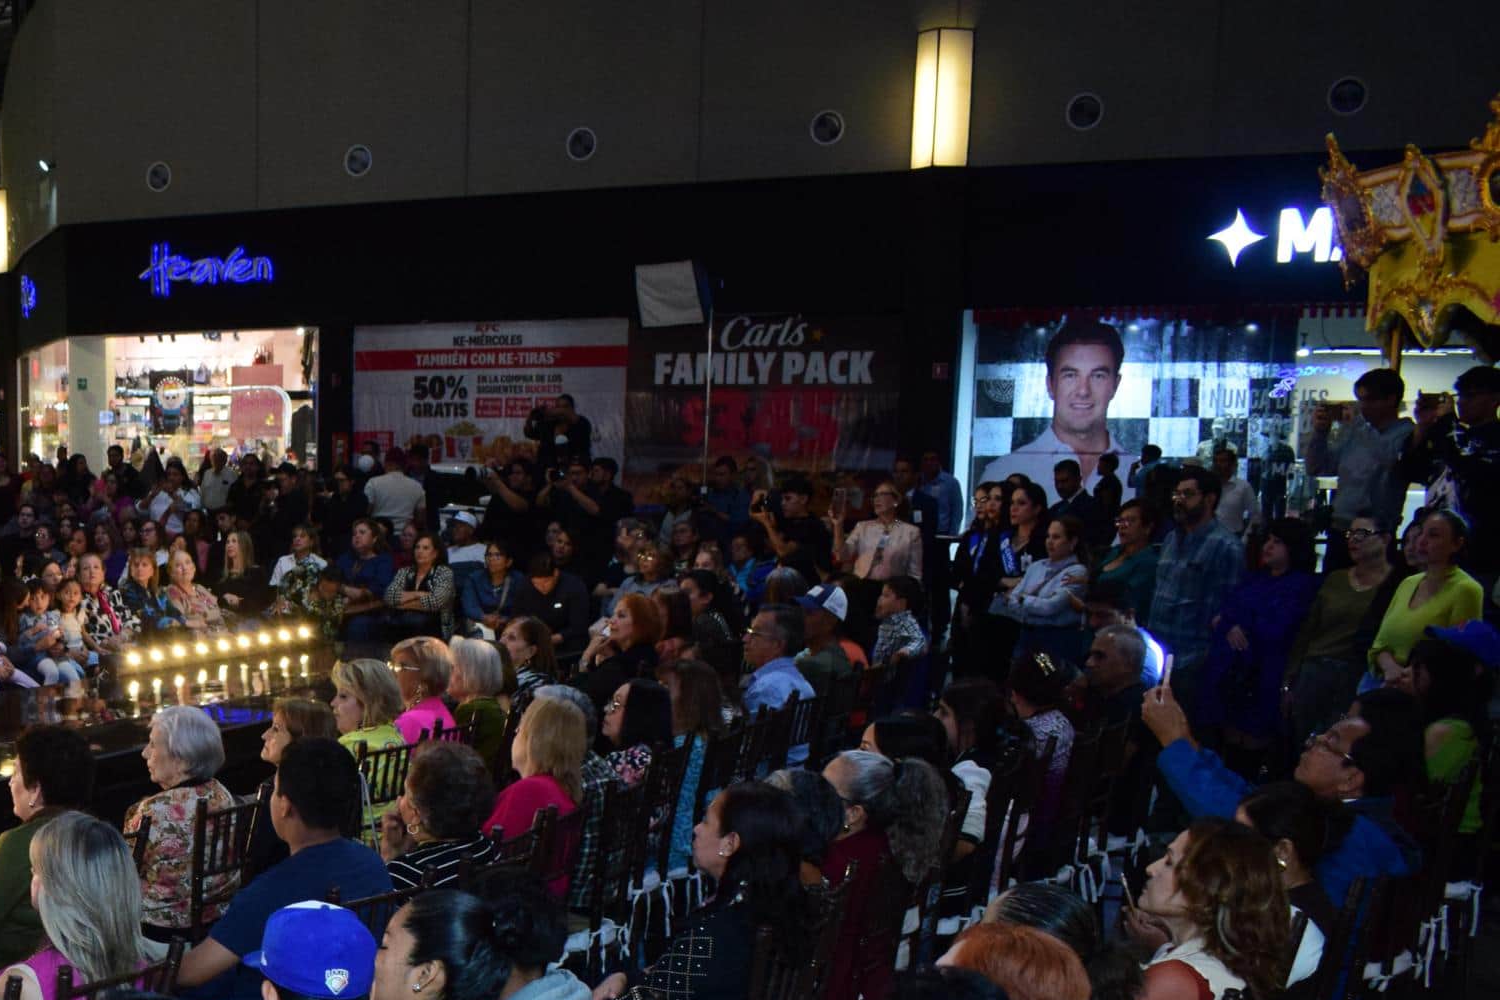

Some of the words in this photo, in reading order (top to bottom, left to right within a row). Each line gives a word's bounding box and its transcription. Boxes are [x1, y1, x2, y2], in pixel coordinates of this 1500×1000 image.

[139, 242, 273, 297] Heaven
[720, 313, 808, 351] Carl's
[414, 350, 468, 367] TAMBIÉN
[469, 352, 495, 366] CON
[653, 351, 777, 385] FAMILY
[781, 350, 875, 385] PACK
[413, 375, 469, 400] 50%
[412, 402, 469, 418] GRATIS
